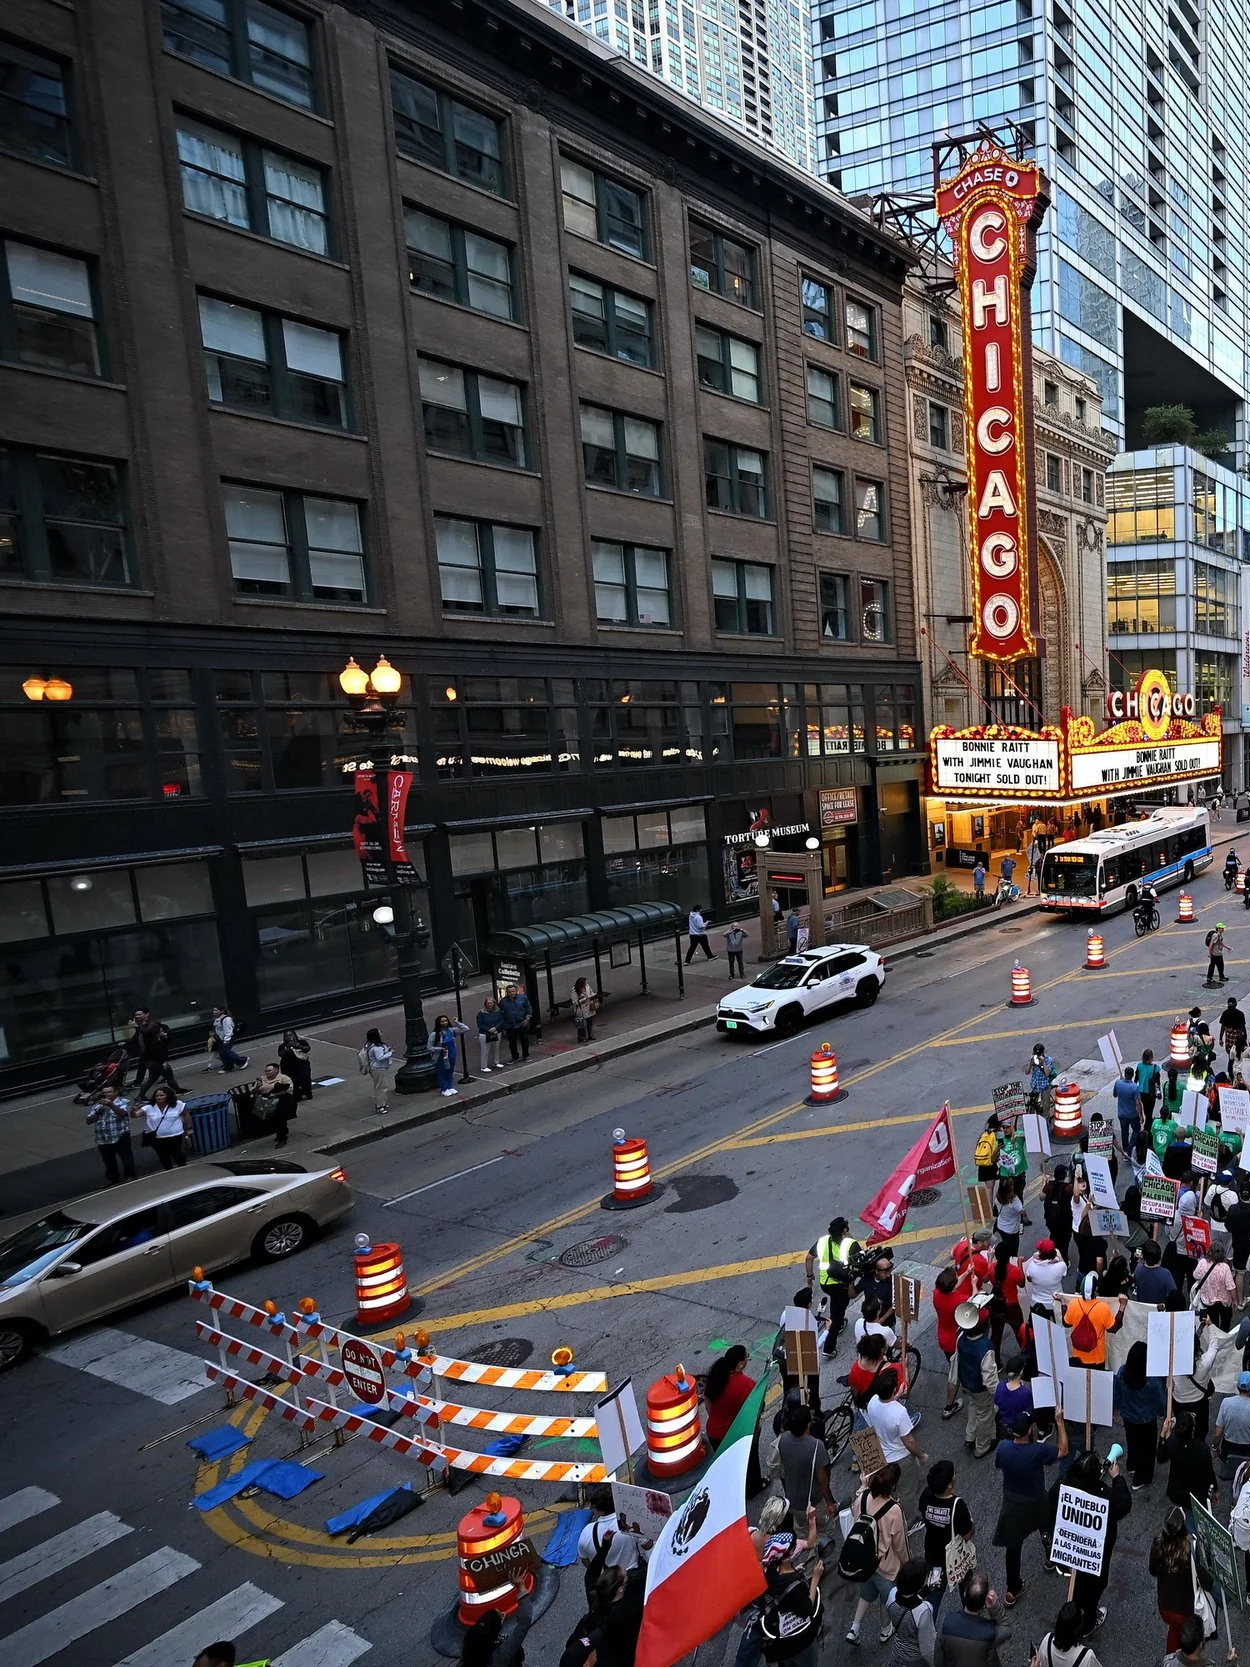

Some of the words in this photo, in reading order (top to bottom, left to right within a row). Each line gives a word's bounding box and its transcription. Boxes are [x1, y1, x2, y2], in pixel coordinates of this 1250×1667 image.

[953, 168, 1003, 199] CHASE
[970, 211, 1021, 639] CHICAGO
[1111, 691, 1195, 717] CHICAGO
[962, 741, 995, 753] BONNIE
[1002, 742, 1030, 753] RAITT
[1136, 750, 1158, 763] BONNIE
[1158, 748, 1176, 761] RAITT
[943, 757, 964, 768] WITH
[969, 757, 1002, 768] JIMMIE
[1007, 757, 1053, 770] VAUGHAN
[1101, 768, 1120, 782] WITH
[1122, 764, 1143, 780] JIMMIE
[1145, 761, 1172, 777] VAUGHAN
[1174, 759, 1189, 773] SOLD
[1189, 757, 1201, 770] OUT!
[954, 773, 992, 784] TONIGHT
[996, 773, 1021, 785] SOLD
[1025, 774, 1047, 786] OUT!
[822, 801, 834, 811] SPACE
[834, 801, 843, 810] FOR
[843, 800, 855, 809] LEASE
[391, 775, 405, 852] CARMEN
[725, 828, 771, 845] TORTURE
[772, 823, 810, 838] MUSEUM
[993, 1084, 1011, 1095] STOP
[1089, 1121, 1104, 1129] STOP
[1194, 1133, 1218, 1148] CHICAGO
[1193, 1144, 1218, 1158] PALESTINE
[917, 1156, 952, 1174] rganization
[1193, 1153, 1217, 1165] OCCUPATION
[1201, 1161, 1217, 1171] CRIME!
[1143, 1181, 1175, 1193] CHICAGO
[1142, 1200, 1174, 1210] OCCUPATION
[1143, 1191, 1176, 1204] PALESTINE
[1154, 1207, 1173, 1217] CRIME!
[345, 1348, 357, 1360] DO
[359, 1354, 376, 1368] NOT
[353, 1377, 378, 1396] ENTER
[859, 1440, 873, 1453] ICE
[1061, 1492, 1073, 1505] ¡EL
[1075, 1496, 1107, 1514] PUEBLO
[1061, 1505, 1103, 1531] UNIDO
[1054, 1538, 1059, 1546] A
[1060, 1540, 1072, 1550] LAS
[1072, 1545, 1102, 1560] FAMILIAS
[470, 1542, 530, 1572] CHINGA
[1052, 1549, 1100, 1572] MIGRANTES!
